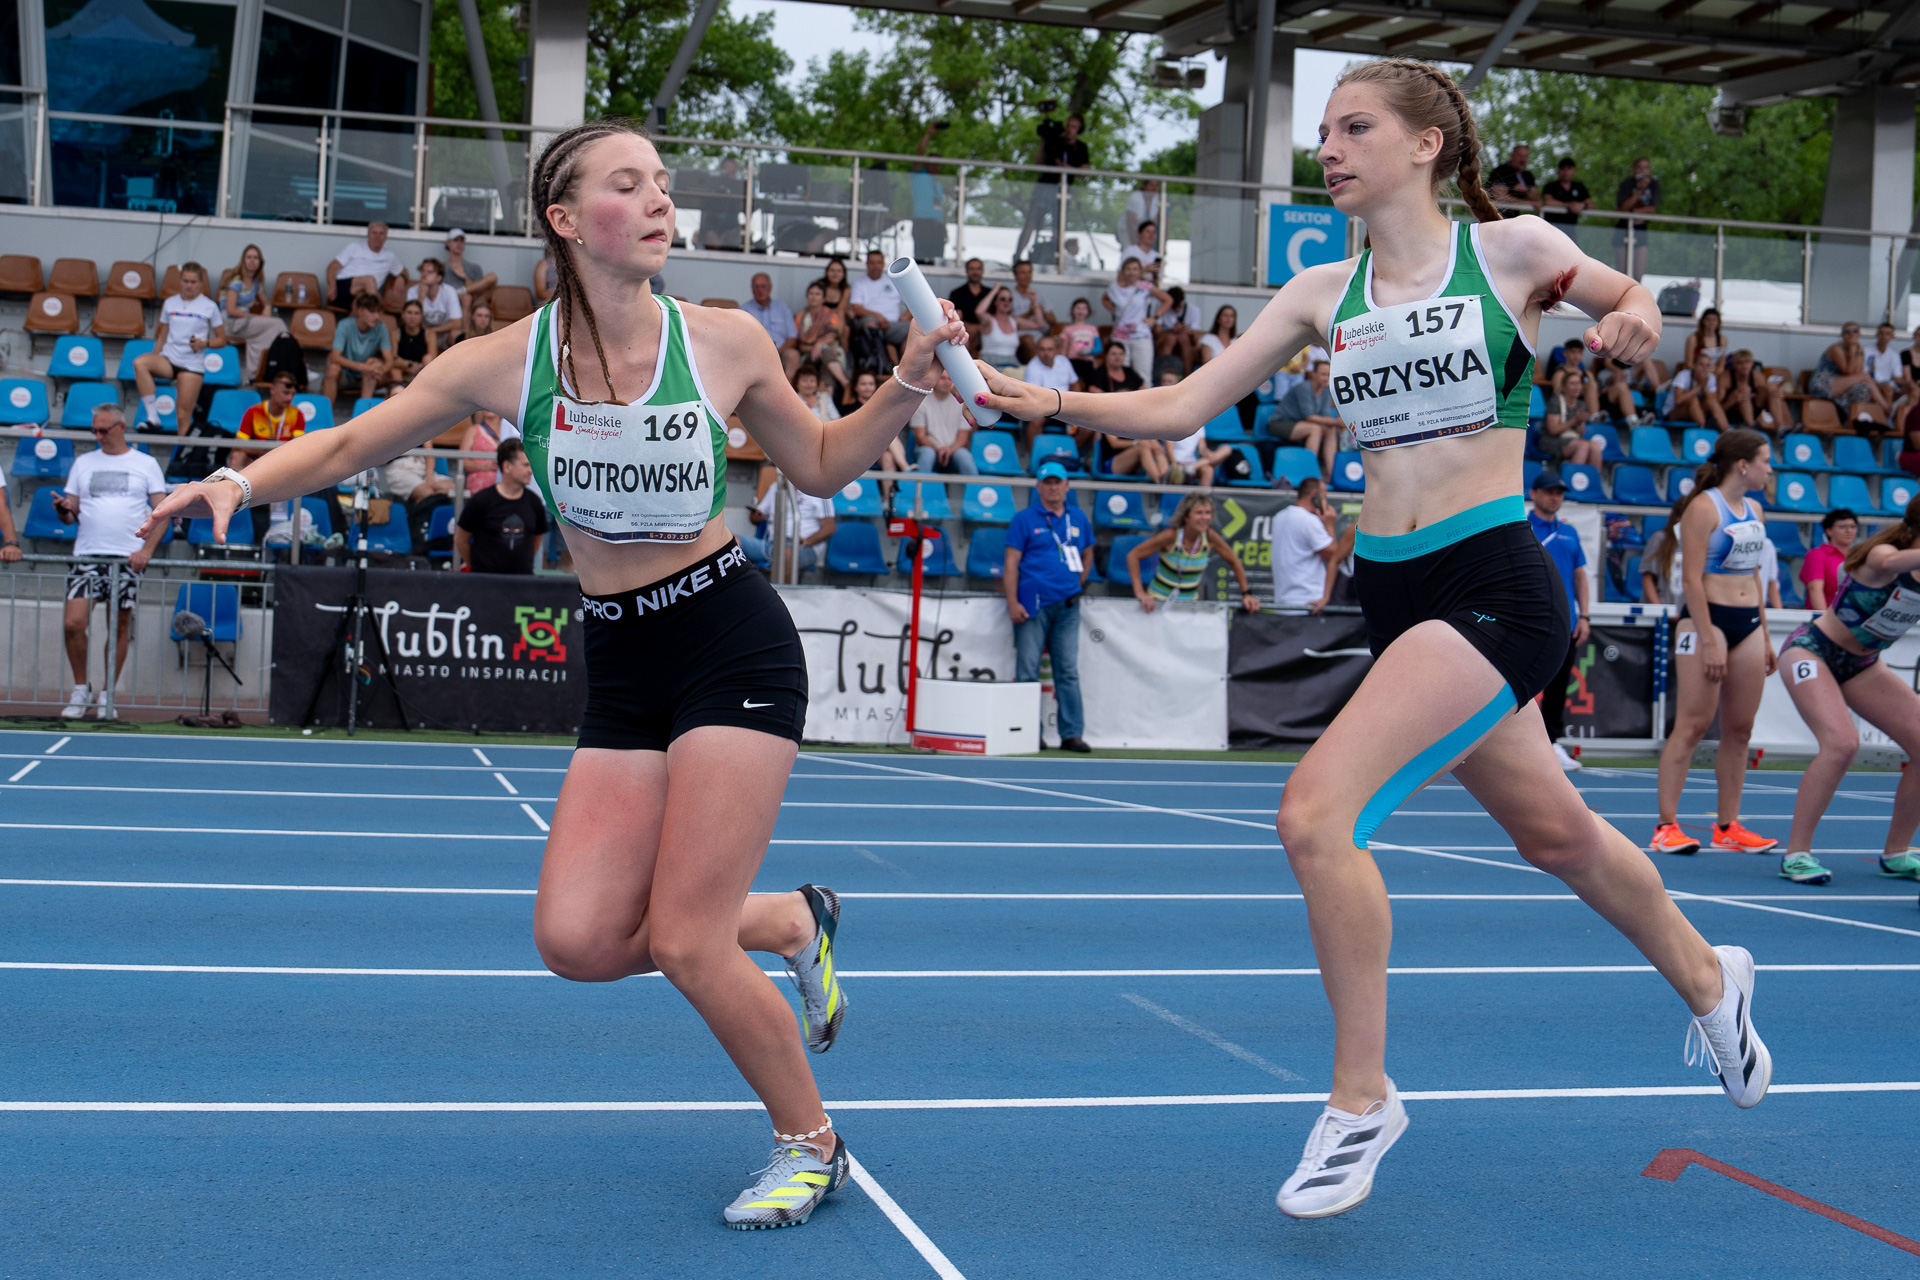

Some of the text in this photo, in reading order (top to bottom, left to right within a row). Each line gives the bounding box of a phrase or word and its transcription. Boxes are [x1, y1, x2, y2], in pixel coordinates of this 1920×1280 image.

[1283, 210, 1332, 225] SEKTOR
[1286, 227, 1328, 275] C
[1405, 303, 1465, 338] 157
[1333, 349, 1488, 405] BRZYSKA
[643, 411, 698, 441] 169
[1361, 412, 1410, 429] LUBELSKIE
[1440, 413, 1471, 422] Mistrzostwa
[1363, 426, 1386, 438] 2024
[1371, 420, 1486, 448] LUBLIN 5-7.07.2024
[554, 456, 710, 493] PIOTROWSKA
[572, 505, 624, 520] LUBELSKIE
[573, 513, 595, 526] 2024
[580, 525, 697, 540] LUBLIN 5-7.07.2024
[1446, 520, 1485, 541] PIERRE
[1368, 541, 1430, 559] PIERRE ROBERT
[636, 564, 714, 617] NIKE
[315, 600, 505, 660] Lublin
[1680, 633, 1691, 652] 4
[378, 663, 567, 684] MIASTO INSPIRACJI
[1797, 661, 1811, 679] 6
